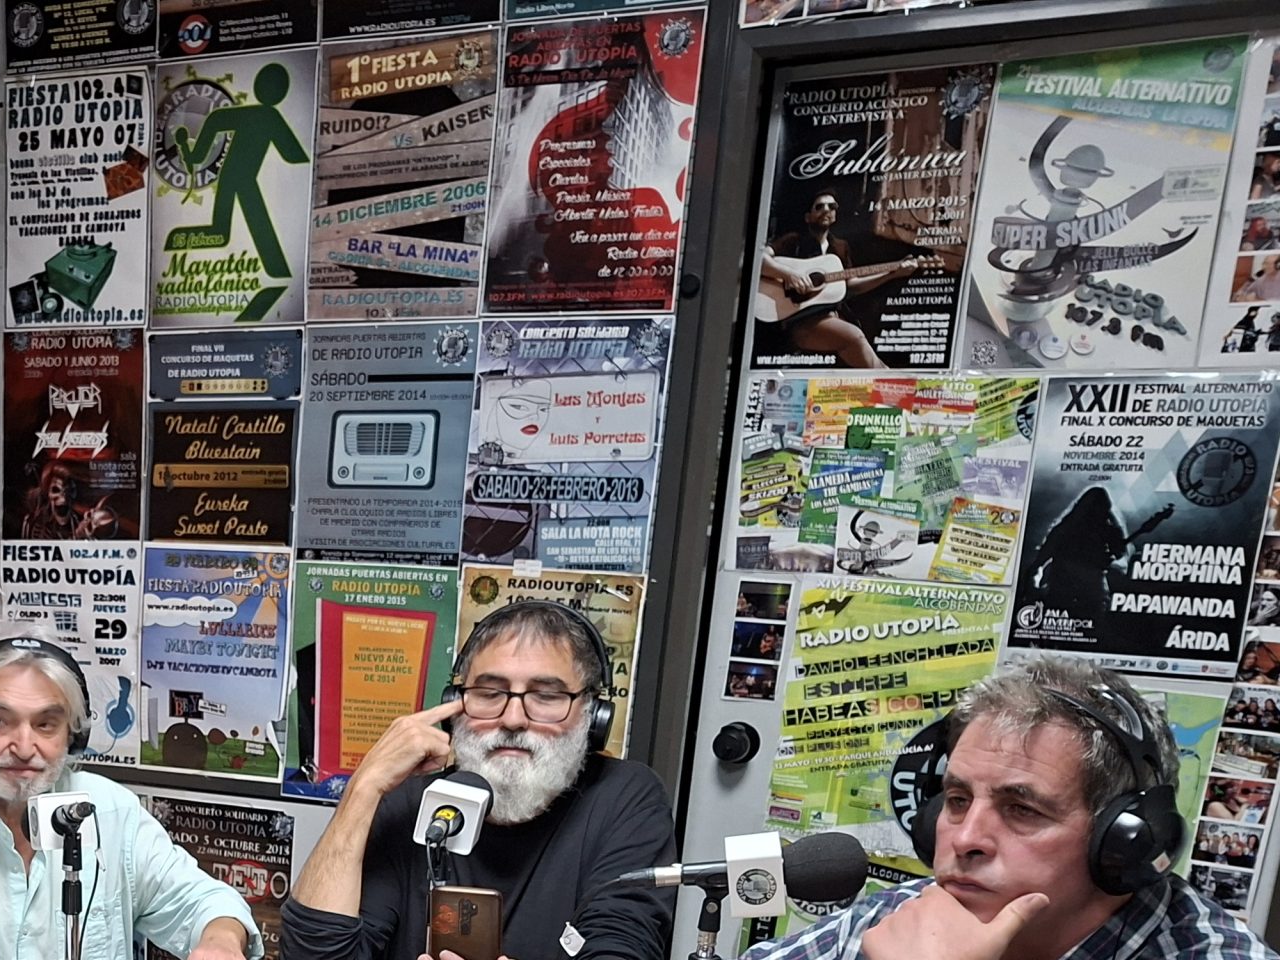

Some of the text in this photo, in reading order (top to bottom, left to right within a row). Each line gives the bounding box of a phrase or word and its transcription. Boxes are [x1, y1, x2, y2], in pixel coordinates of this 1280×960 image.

[372, 48, 438, 75] FIESTA
[509, 43, 638, 68] RADIO UTOPÍA
[341, 70, 452, 99] RADIO UTOPIA
[789, 82, 895, 104] RADIO UTOPÍA
[1025, 75, 1232, 106] FESTIVAL ALTERNATIVO
[8, 83, 71, 108] FIESTA
[8, 99, 143, 129] RADIO UTOPIA
[793, 101, 863, 116] CONCIERTO
[812, 110, 893, 126] Y ENTREVISTA
[320, 104, 493, 141] RUIDO!? KAISER
[18, 123, 136, 152] 25 MAYO 07
[337, 191, 437, 225] DICIEMBRE
[442, 181, 487, 205] 2006
[887, 197, 935, 211] MARZO
[938, 195, 968, 208] 2015
[994, 203, 1132, 250] SUPER SKUNK
[348, 238, 382, 254] BAR
[162, 251, 261, 278] Maratón
[156, 273, 261, 298] radiofónico
[156, 292, 251, 308] RADIOUTOPIA
[31, 336, 113, 349] RADIO UTOPIA
[24, 357, 62, 368] SABADO
[70, 356, 96, 367] JUNIO
[99, 355, 120, 366] 2013
[161, 355, 201, 364] CONCURSO
[212, 353, 254, 363] MAQUETAS
[312, 346, 423, 361] DE RADIO UTOPIA
[167, 368, 241, 378] DE RADIO UTOPIA
[311, 369, 366, 386] SÁBADO
[309, 389, 427, 402] 20 SEPTIEMBRE 2014
[1063, 382, 1273, 413] XXII FESTIVAL ALTERNATIVO
[1131, 396, 1269, 413] DE RADIO UTOPÍA
[165, 415, 286, 439] Natali Castillo
[1060, 415, 1265, 428] FINAL X CONCURSO DE MAQUETAS
[1069, 432, 1144, 447] SÁBADO 22
[185, 440, 261, 460] Bluestain
[1063, 451, 1145, 461] NOVIEMBRE 2014
[171, 471, 238, 481] octubre 2012
[1060, 463, 1101, 472] ENTRADA
[478, 477, 640, 500] SABADO-23-FEBRERO-2013
[194, 492, 249, 514] Eureka
[174, 516, 268, 536] Sweet Paste
[541, 526, 642, 539] SALA LA NOTA ROCK
[3, 545, 64, 562] FIESTA
[70, 549, 98, 559] 102.4
[1141, 543, 1246, 566] HERMANA
[2, 565, 136, 586] RADIO UTOPÍA
[306, 566, 449, 582] JORNADAS PUERTAS ABIERTAS EN
[1131, 562, 1242, 585] MORPHINA
[332, 580, 371, 593] RADIO
[817, 578, 1005, 605] XIV FESTIVAL ALTERNATIVO
[93, 605, 126, 613] JUEVES
[355, 594, 387, 604] ENERO
[388, 595, 407, 606] 2015
[913, 598, 1003, 615] ALCOBENDAS
[1110, 593, 1236, 619] PAPAWANDA
[94, 619, 127, 640] 29
[800, 612, 960, 649] RADIO UTOPÍA
[1166, 625, 1230, 652] ÁRIDA
[95, 647, 126, 656] MARZO
[354, 652, 405, 664] NUEVO AÑO
[99, 657, 121, 667] 2007
[374, 664, 413, 675] BALANCE
[363, 673, 396, 683] DE 2014
[804, 672, 908, 699] ESTIRPE
[782, 687, 962, 727] HABEAS CORP
[175, 804, 268, 823] CONCIERTO SOLIDARIO
[176, 817, 267, 838] RADIO UTOPÍA
[169, 832, 290, 855] BADO 5 OCTUBRE 2013
